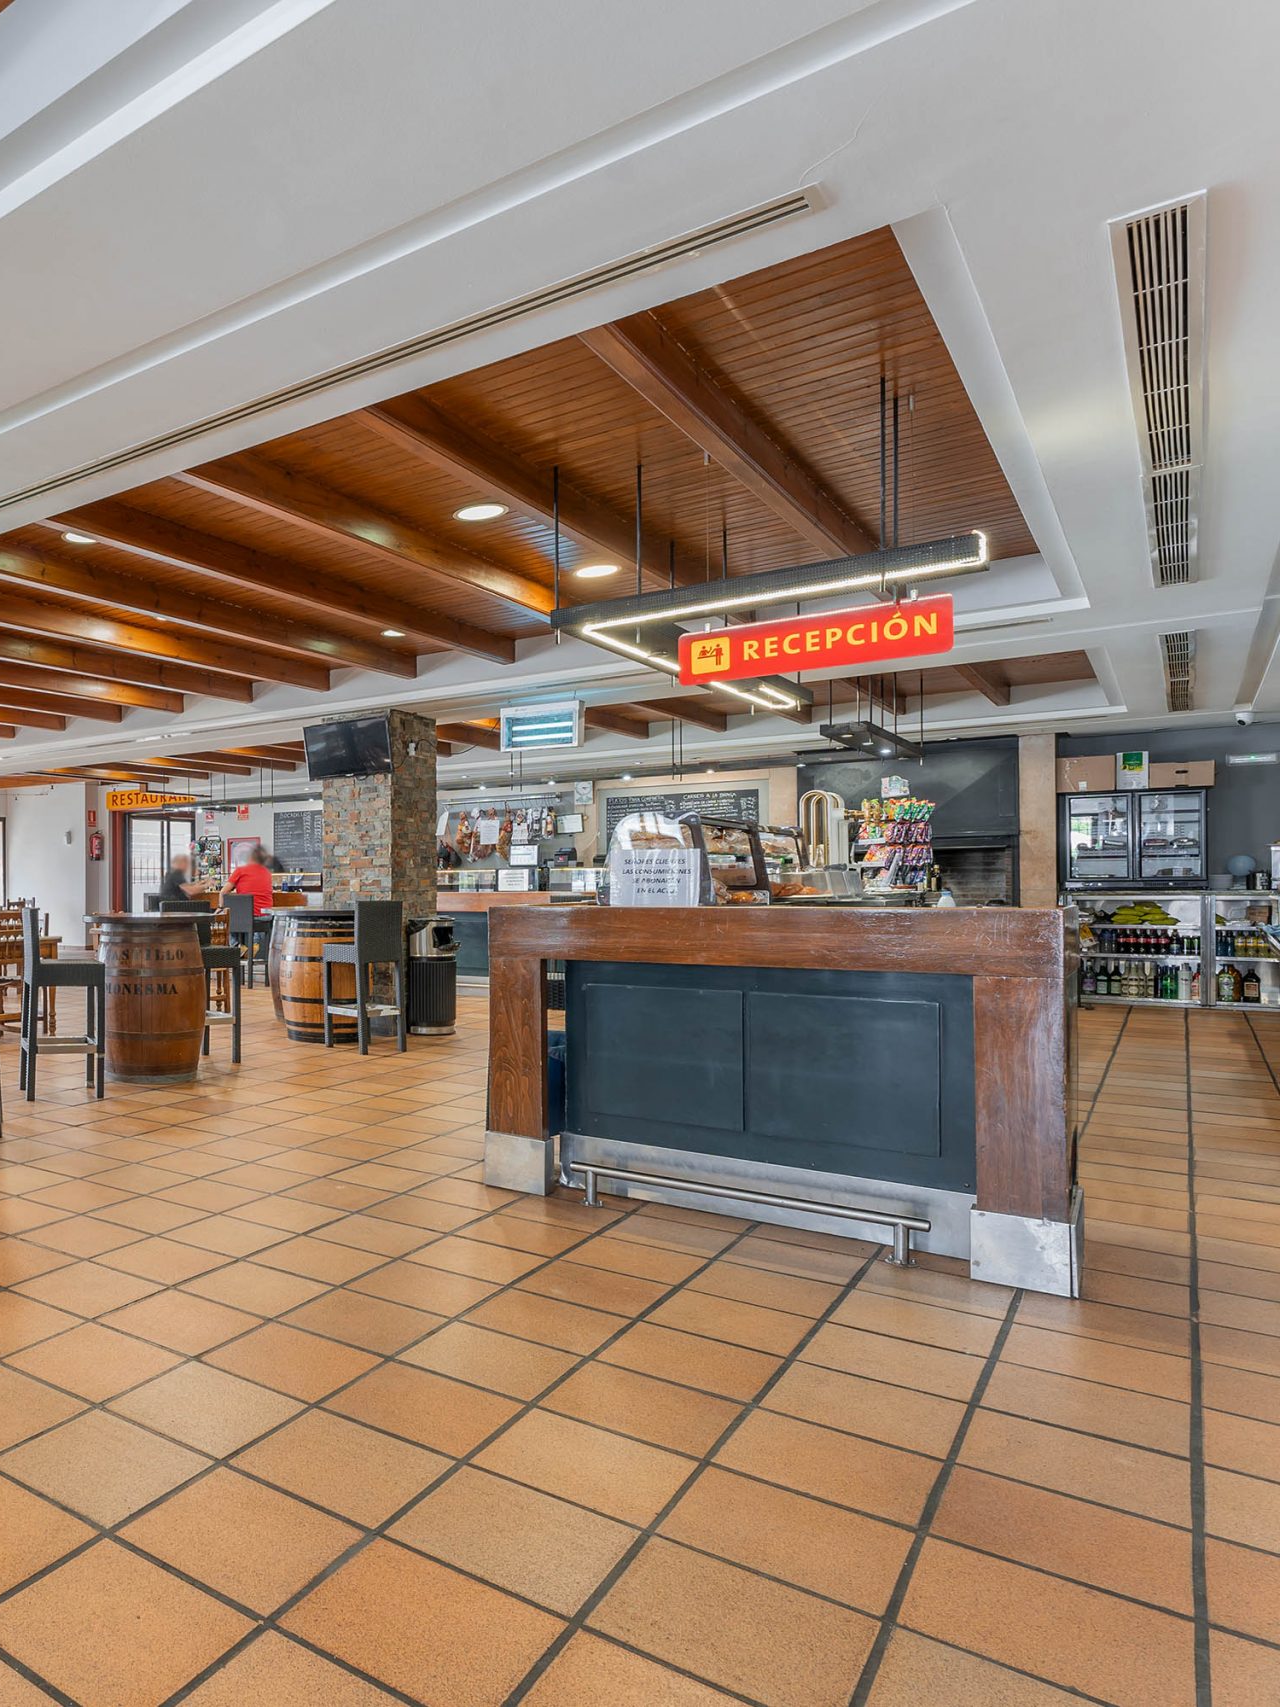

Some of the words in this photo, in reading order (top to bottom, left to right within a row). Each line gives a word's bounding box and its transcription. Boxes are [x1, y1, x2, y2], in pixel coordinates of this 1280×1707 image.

[743, 612, 938, 661] RECEPCIÓN
[111, 792, 195, 806] RESTAURA
[105, 948, 184, 961] ASTILLO
